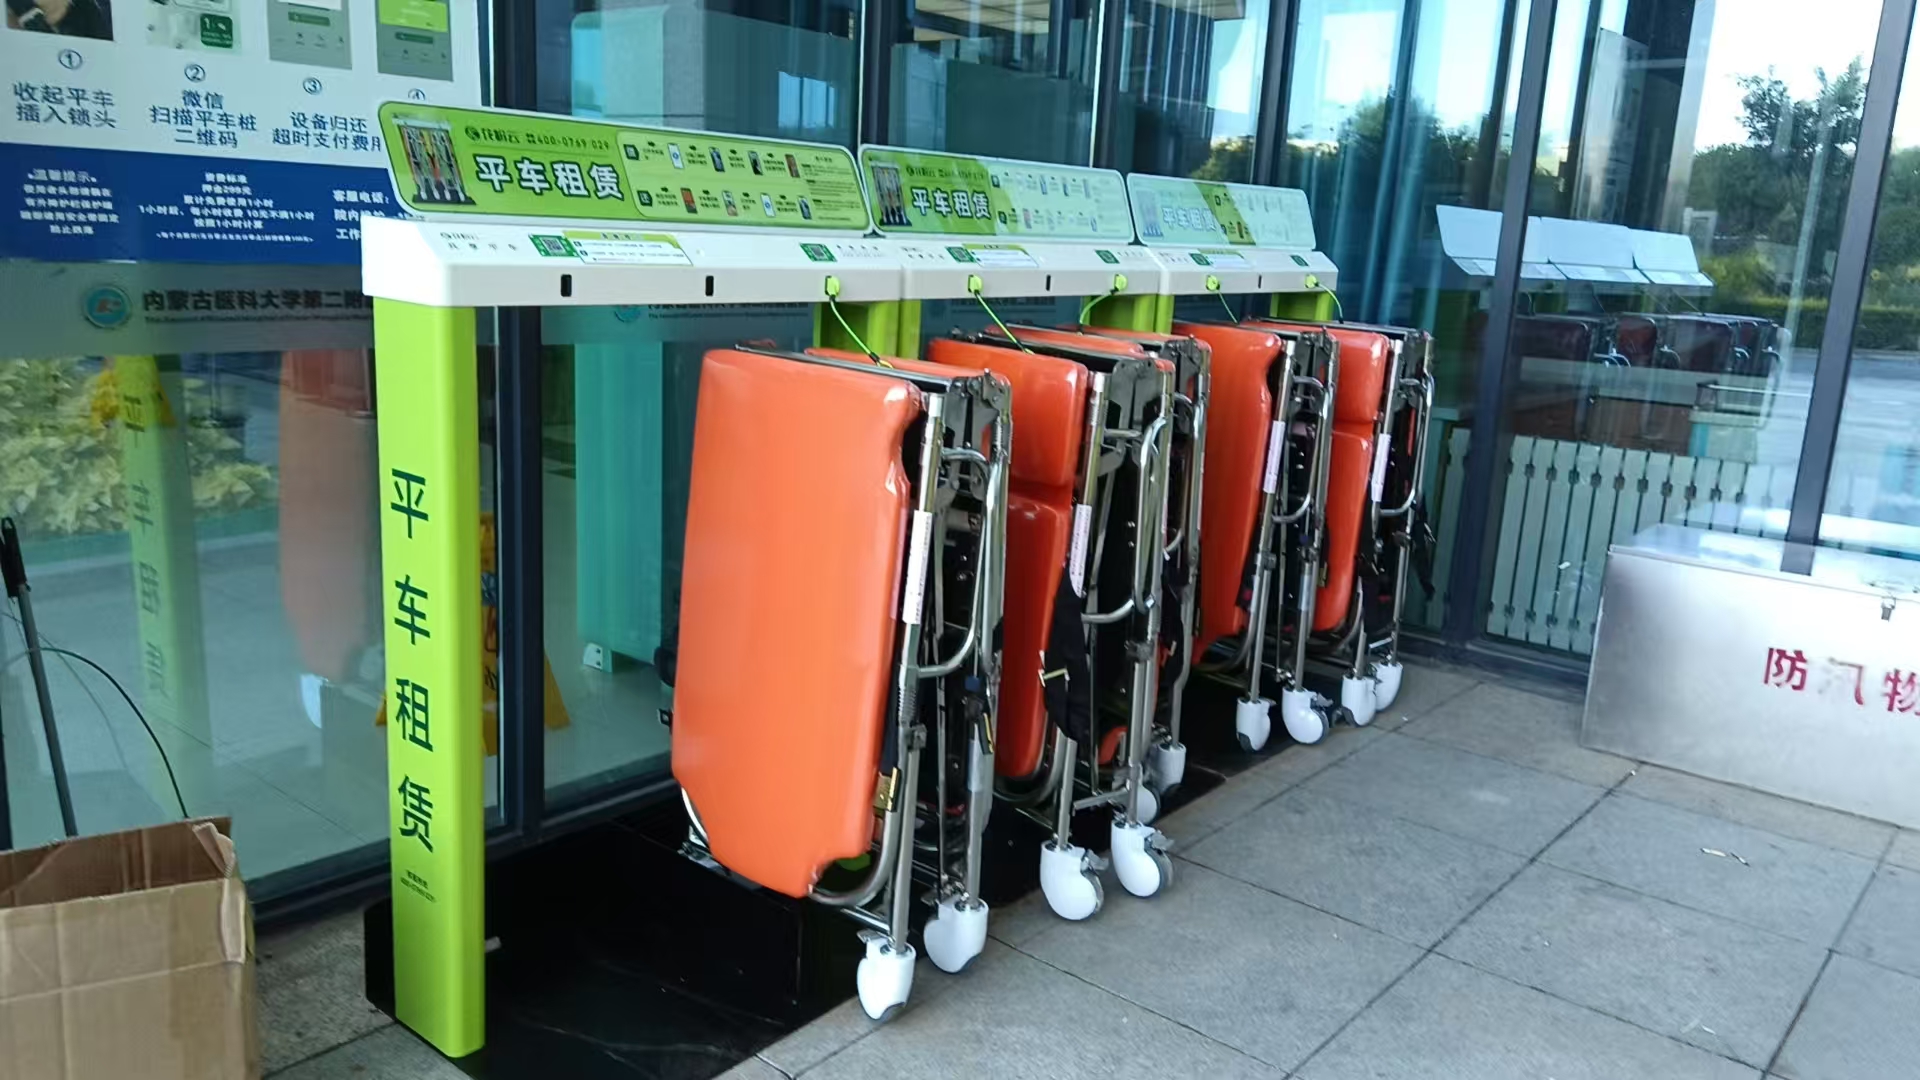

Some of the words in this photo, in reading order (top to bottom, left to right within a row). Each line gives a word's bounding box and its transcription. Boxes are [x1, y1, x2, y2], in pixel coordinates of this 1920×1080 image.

[13, 82, 115, 108] 收起平车
[182, 90, 224, 110] 微信
[16, 103, 117, 129] 插入锁头
[150, 106, 258, 132] 扫描平车桩
[290, 111, 368, 135] 设备归还
[174, 129, 238, 149] 二维码
[473, 154, 625, 201] 平车租赁
[911, 188, 992, 220] 平车租赁
[1161, 206, 1217, 231] 平车租赁
[143, 290, 373, 311] 内蒙古医科大学第二附
[390, 468, 435, 853] 平车租赁
